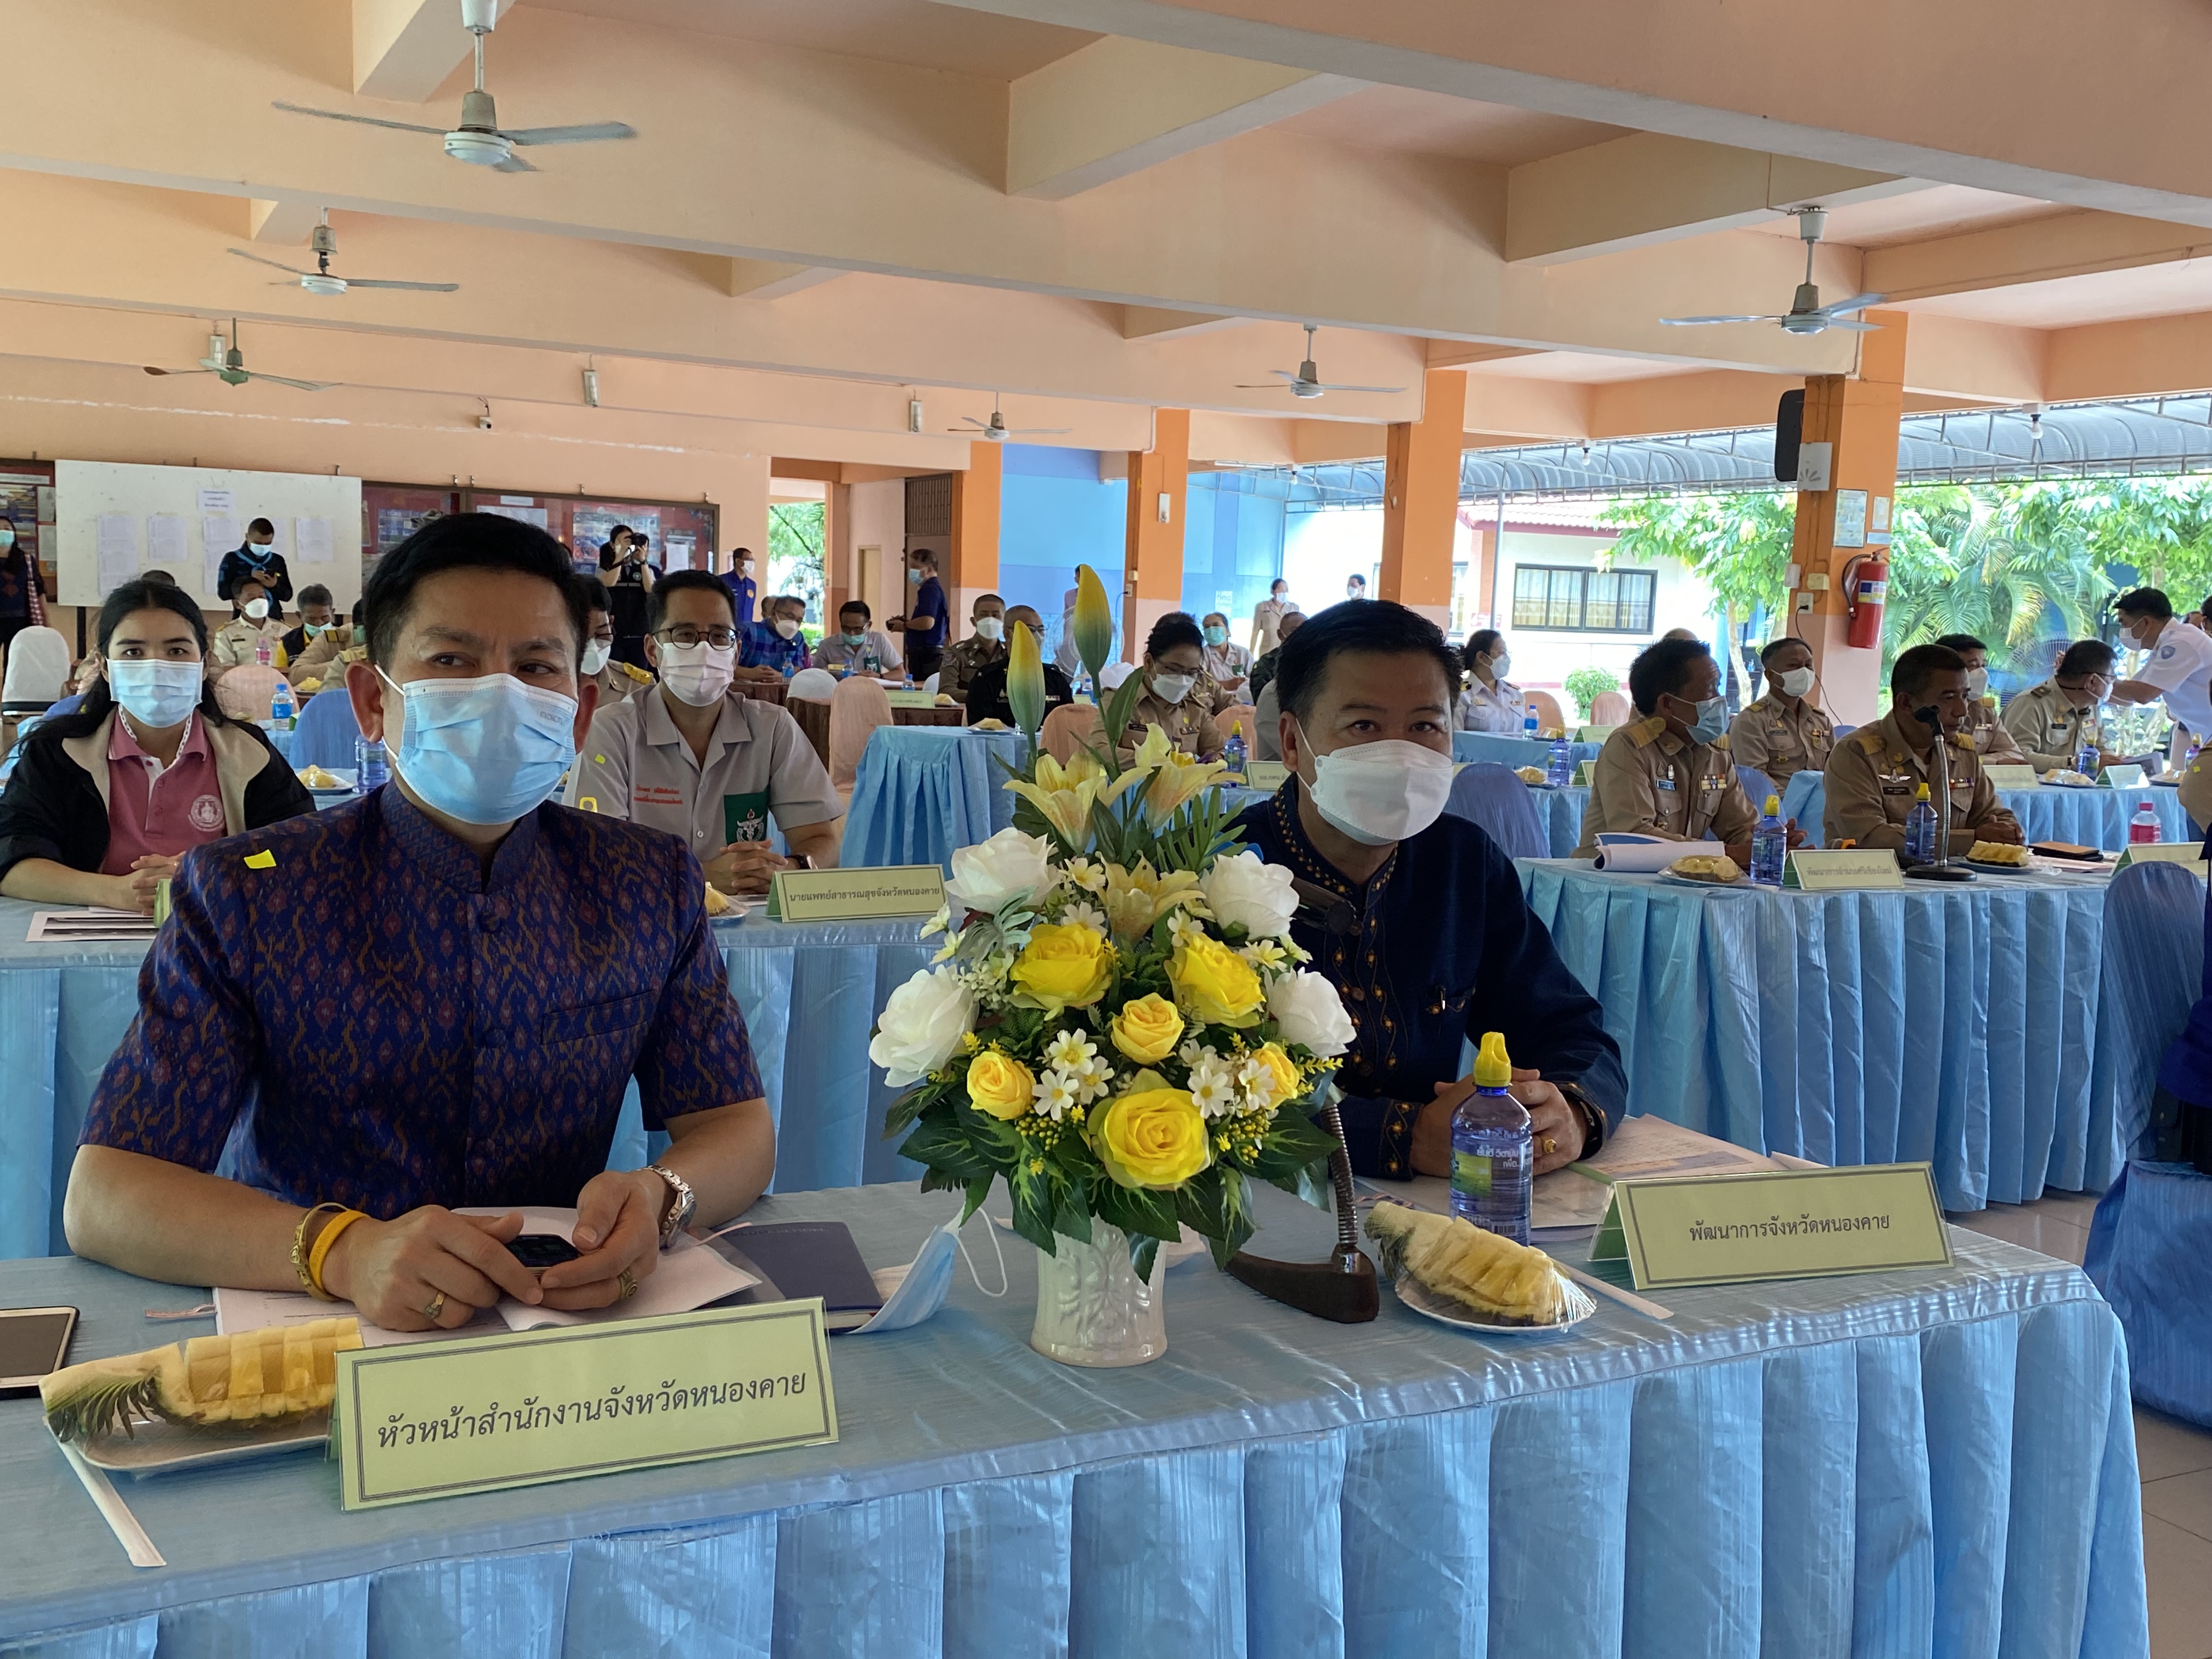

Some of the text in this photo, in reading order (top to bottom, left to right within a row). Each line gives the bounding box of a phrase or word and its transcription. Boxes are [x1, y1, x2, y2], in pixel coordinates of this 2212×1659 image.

[789, 887, 940, 901] นายแพทย์สาธารณสุขจังหวัดหนองคาย
[1689, 1213, 1891, 1242] พัฒนาการจังหวัดหนองคาย
[377, 1370, 806, 1449] หัวหน้าสำนักงานจังหวัดหนองคาย
